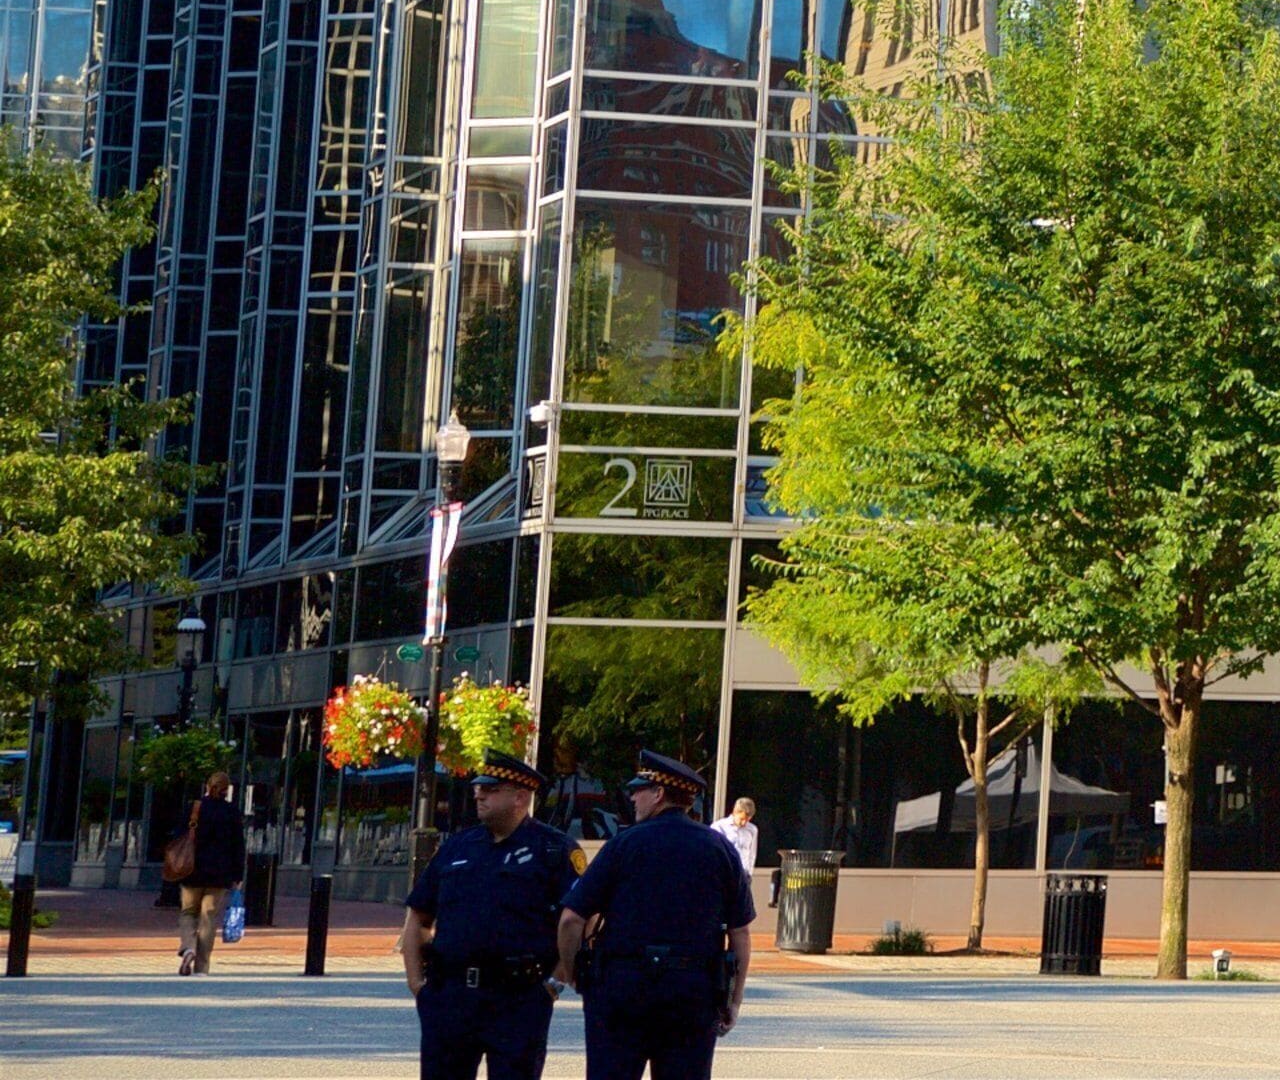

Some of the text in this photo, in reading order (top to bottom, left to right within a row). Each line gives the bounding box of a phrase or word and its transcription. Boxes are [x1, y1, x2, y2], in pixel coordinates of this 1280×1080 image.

[600, 458, 638, 517] 2
[643, 508, 689, 519] PPG PLACE
